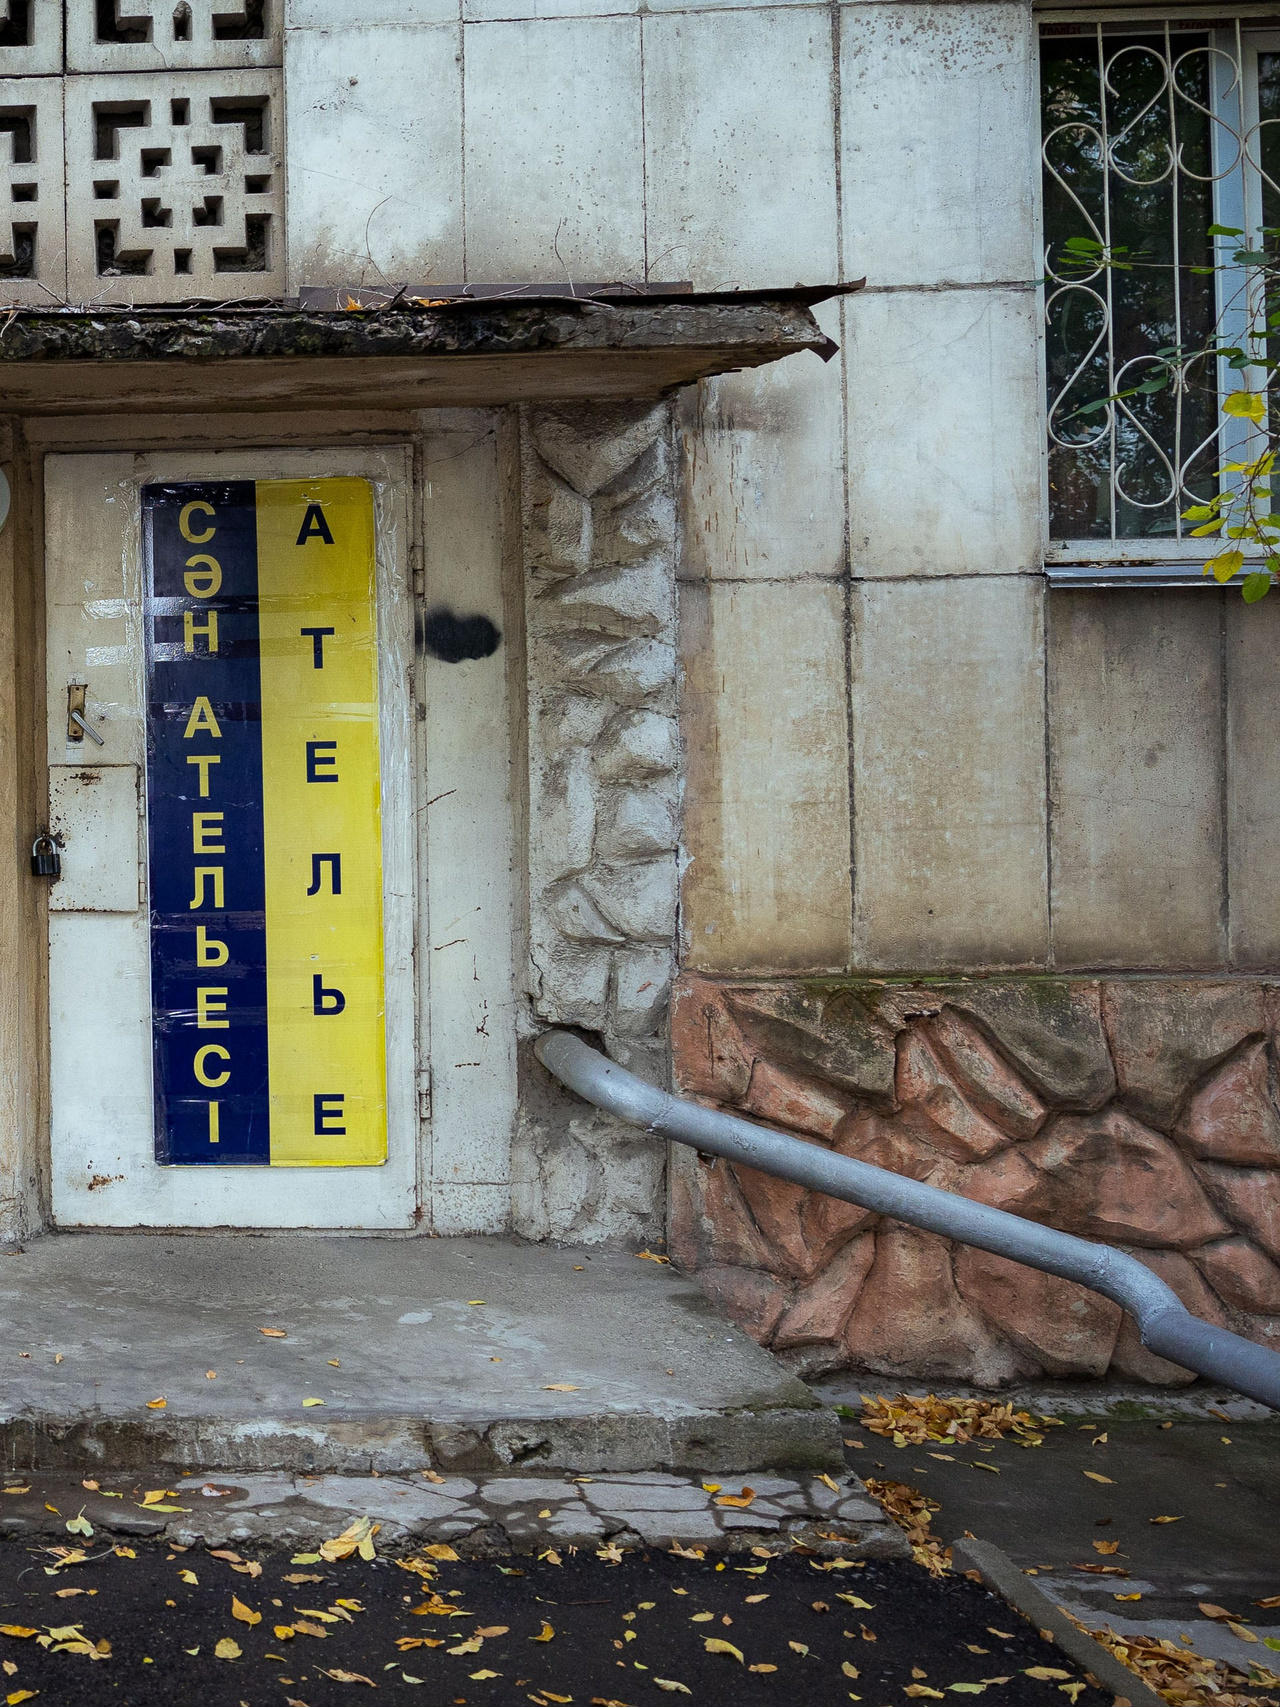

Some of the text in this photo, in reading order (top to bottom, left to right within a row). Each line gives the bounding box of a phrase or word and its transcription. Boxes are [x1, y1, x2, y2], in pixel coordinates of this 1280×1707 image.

[179, 500, 231, 1144] СӘН АТЕЛЬЕСІ
[296, 503, 347, 1136] АТЕЛЬЕ
